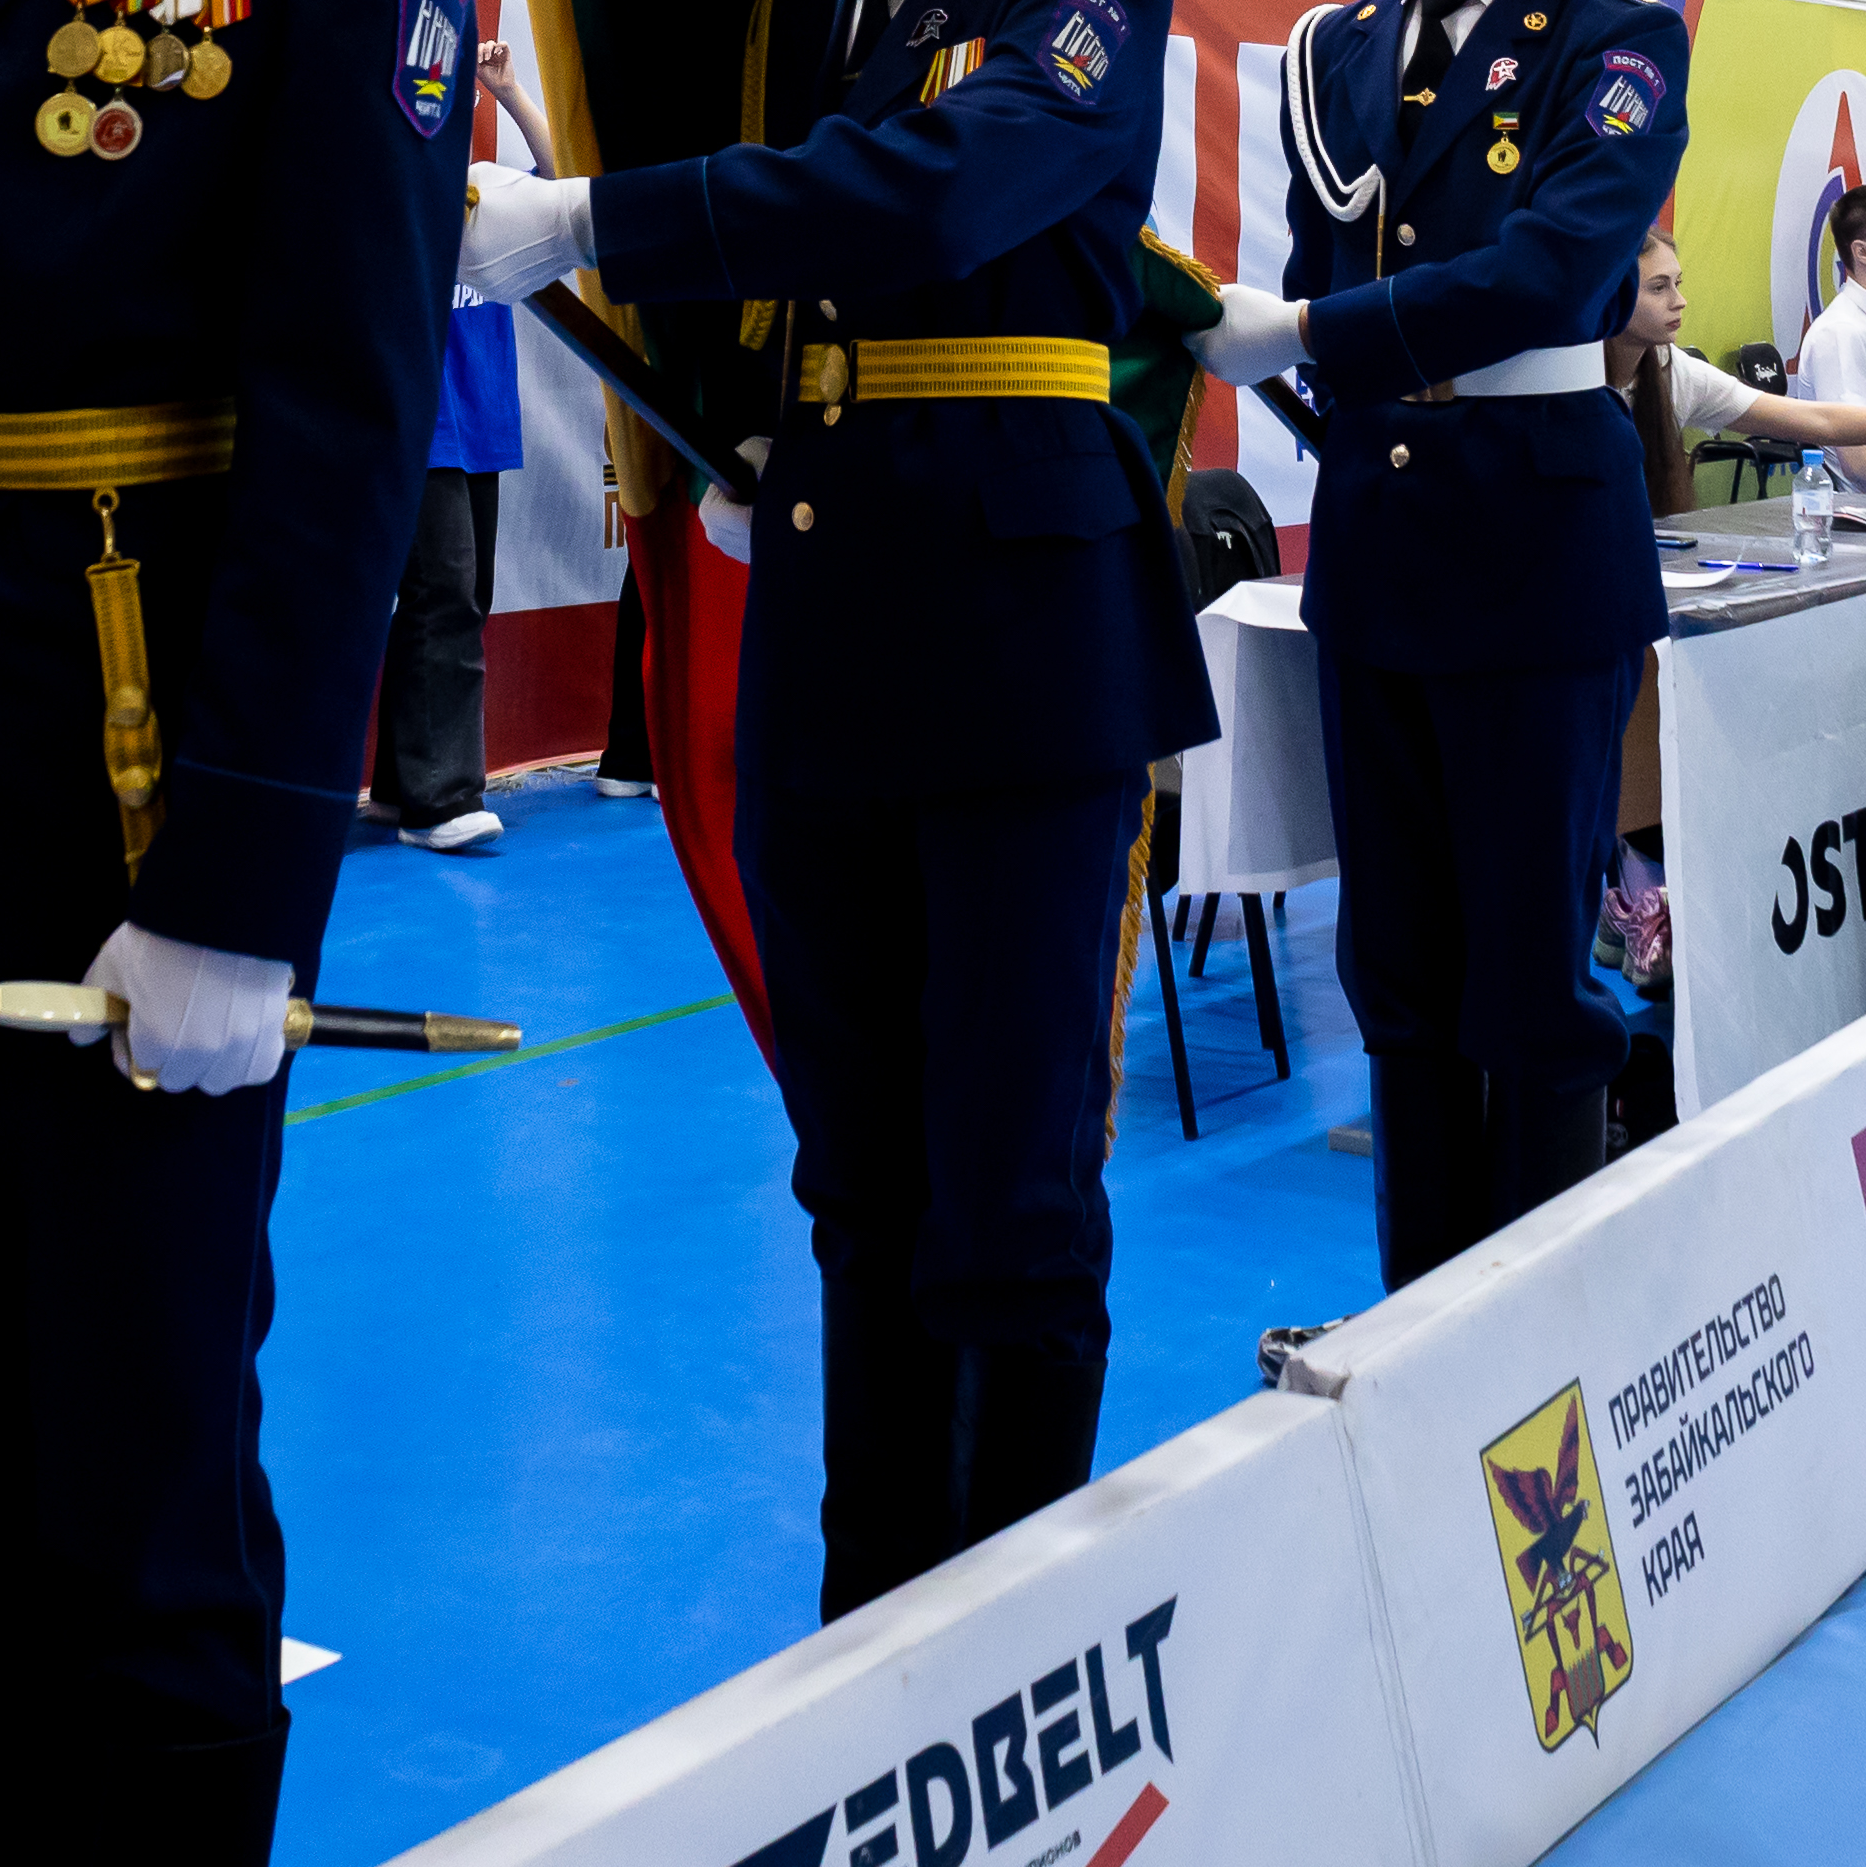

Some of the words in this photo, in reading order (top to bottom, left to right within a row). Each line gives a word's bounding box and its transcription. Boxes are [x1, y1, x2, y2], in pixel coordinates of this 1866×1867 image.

[1058, 71, 1081, 96] ЧИТА
[1613, 55, 1645, 69] ПОСТ
[1608, 1273, 1787, 1450] ПРАВИТЕЛЬСТВО
[1625, 1331, 1815, 1528] ЗАБАЙКАЛЬСКОГО
[1642, 1511, 1705, 1607] КРАЯ
